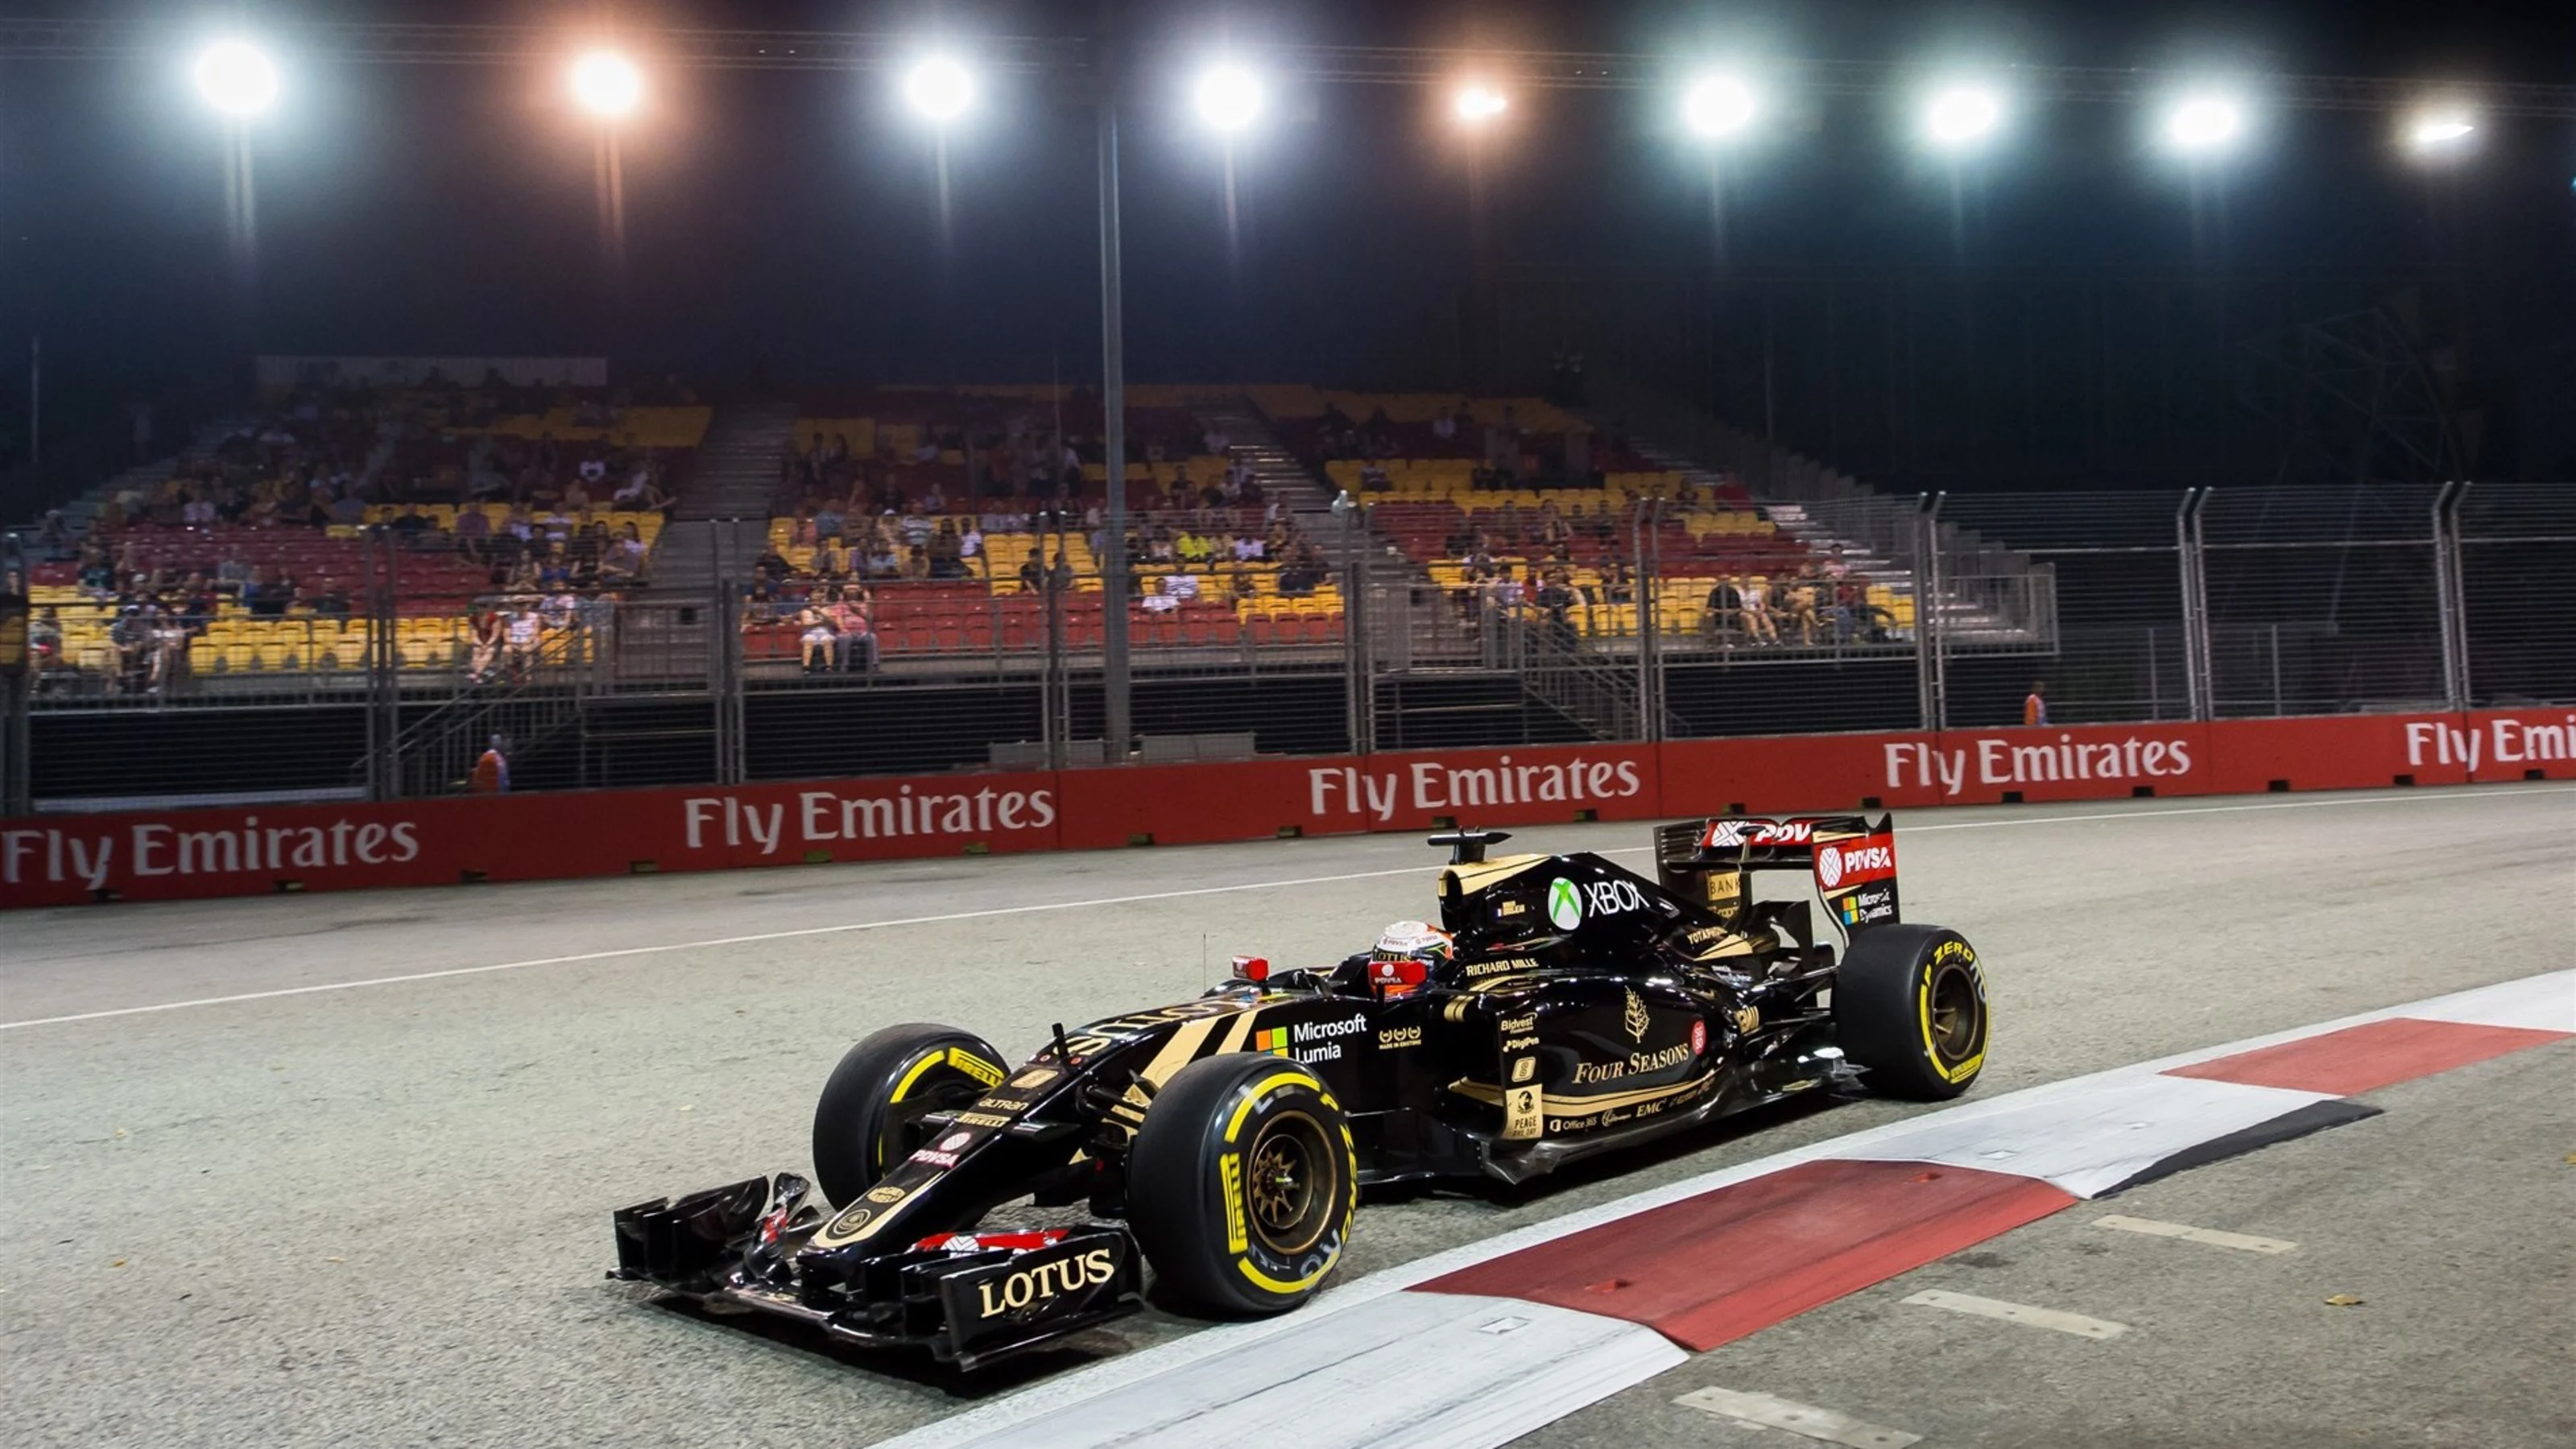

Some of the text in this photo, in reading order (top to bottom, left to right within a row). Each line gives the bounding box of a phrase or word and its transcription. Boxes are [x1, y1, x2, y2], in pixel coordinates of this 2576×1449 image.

[1884, 733, 2192, 795] Fly Emirates
[2405, 723, 2482, 772] Fly
[1309, 755, 1640, 821] Fly Emirates
[684, 784, 1056, 854] Fly Emirates
[2, 815, 419, 890] Fly Emirates
[1845, 846, 1892, 873] PDVSA
[1583, 879, 1651, 919] XBOX
[1466, 958, 1540, 976] RICHARD MILLE
[1934, 940, 1974, 965] ZERO
[1294, 1013, 1367, 1042] Microsoft
[1295, 1041, 1342, 1064] Lumia
[1563, 1120, 1585, 1130] Office
[908, 1149, 960, 1168] PDVSA
[1220, 1152, 1249, 1254] PIRELLI
[978, 1249, 1115, 1318] LOTUS
